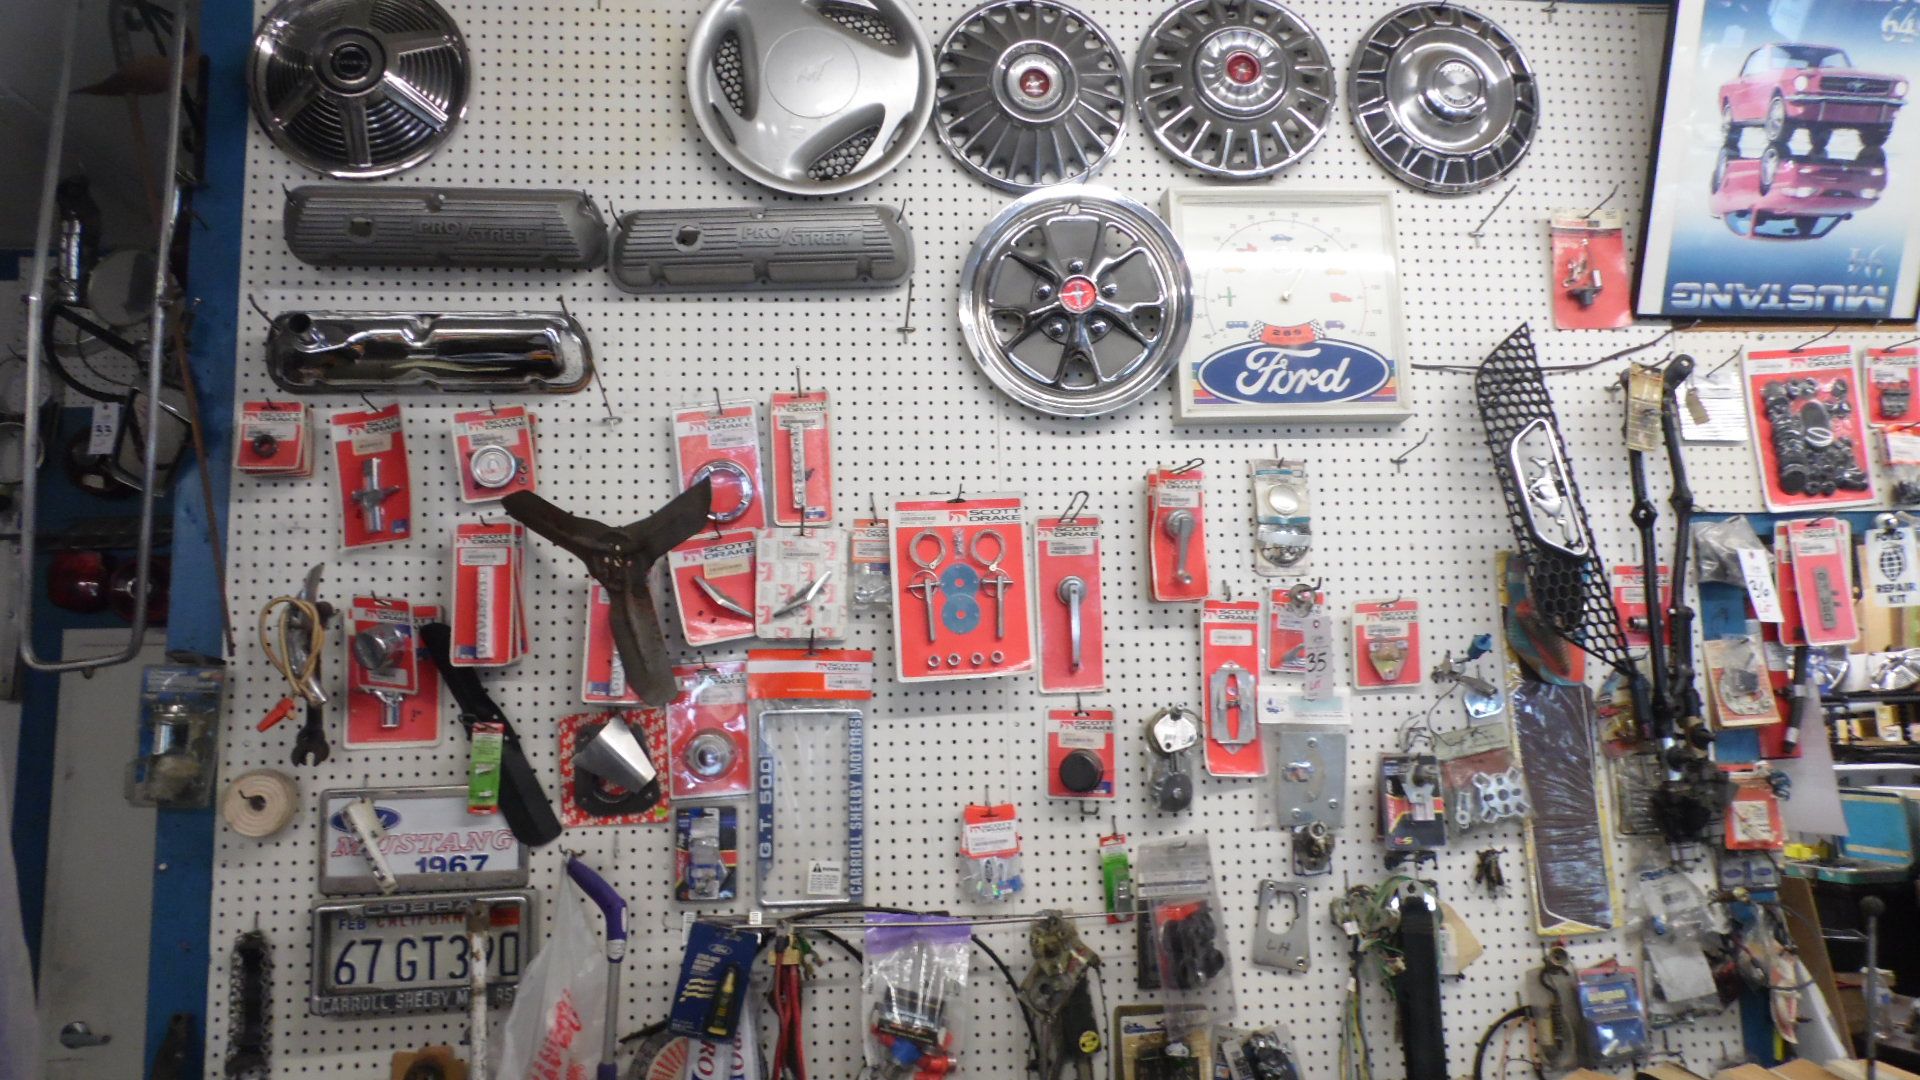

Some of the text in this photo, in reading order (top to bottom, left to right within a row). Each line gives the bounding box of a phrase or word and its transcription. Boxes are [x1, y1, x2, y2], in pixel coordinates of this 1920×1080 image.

[420, 221, 534, 241] PRO STREET
[742, 227, 854, 247] PRO STREET
[1670, 282, 1889, 311] MUSTANG
[1235, 346, 1352, 396] Ford
[969, 508, 1019, 516] SCOTT
[969, 514, 1022, 522] DRAKE
[704, 541, 755, 552] SCOTT
[704, 548, 756, 560] DRAKE
[1306, 651, 1327, 673] 35
[759, 758, 773, 804] 500
[849, 718, 863, 895] CARROLL SHELBY MOTORS
[331, 829, 513, 857] MUSTANG
[415, 854, 489, 874] 1967
[338, 917, 367, 930] FEB
[334, 938, 384, 985] 67
[321, 995, 389, 1014] CARROLL
[396, 990, 450, 1009] SHELBY
